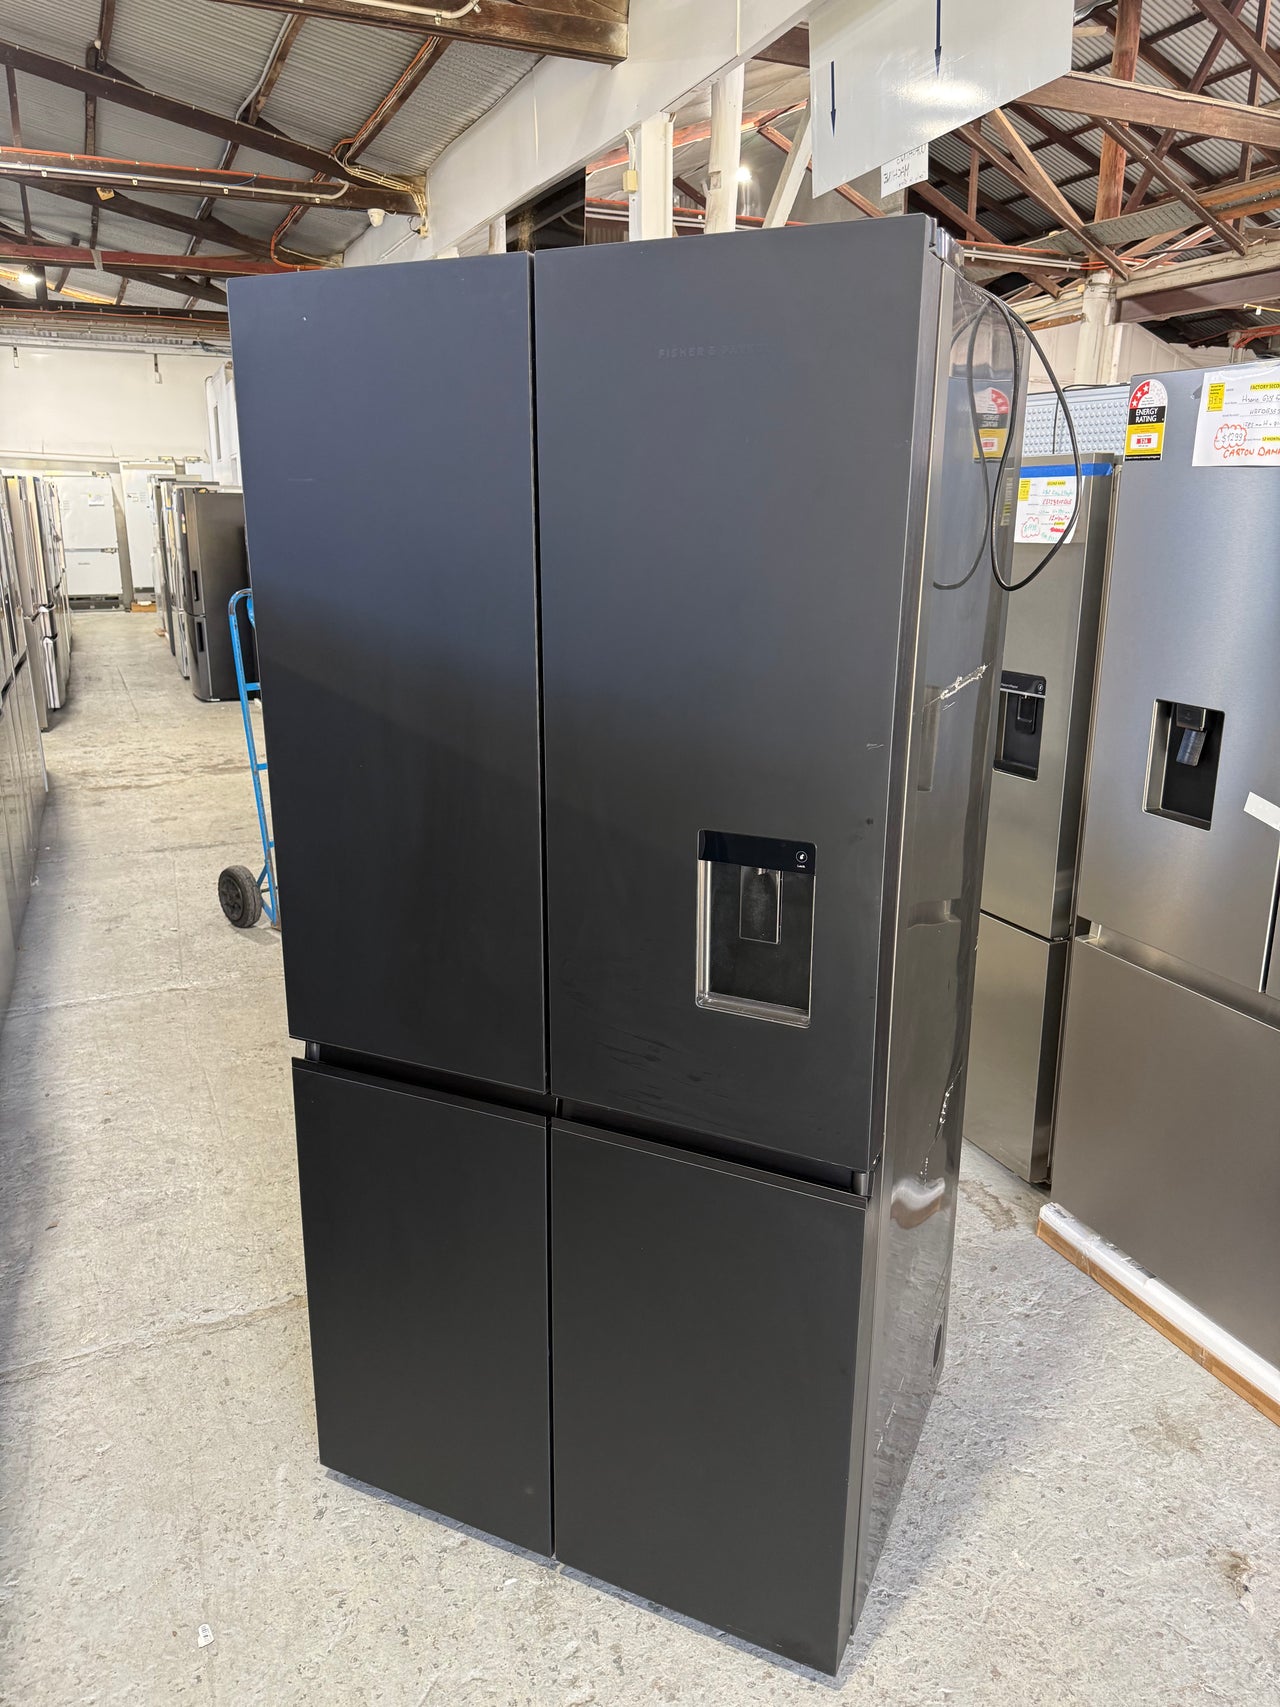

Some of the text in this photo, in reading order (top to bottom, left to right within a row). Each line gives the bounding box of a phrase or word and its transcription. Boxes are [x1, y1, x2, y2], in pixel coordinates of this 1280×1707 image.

[657, 346, 705, 360] FISHER
[1135, 407, 1159, 416] ENERGY
[1135, 415, 1157, 423] RATING
[1223, 448, 1255, 459] CARTON
